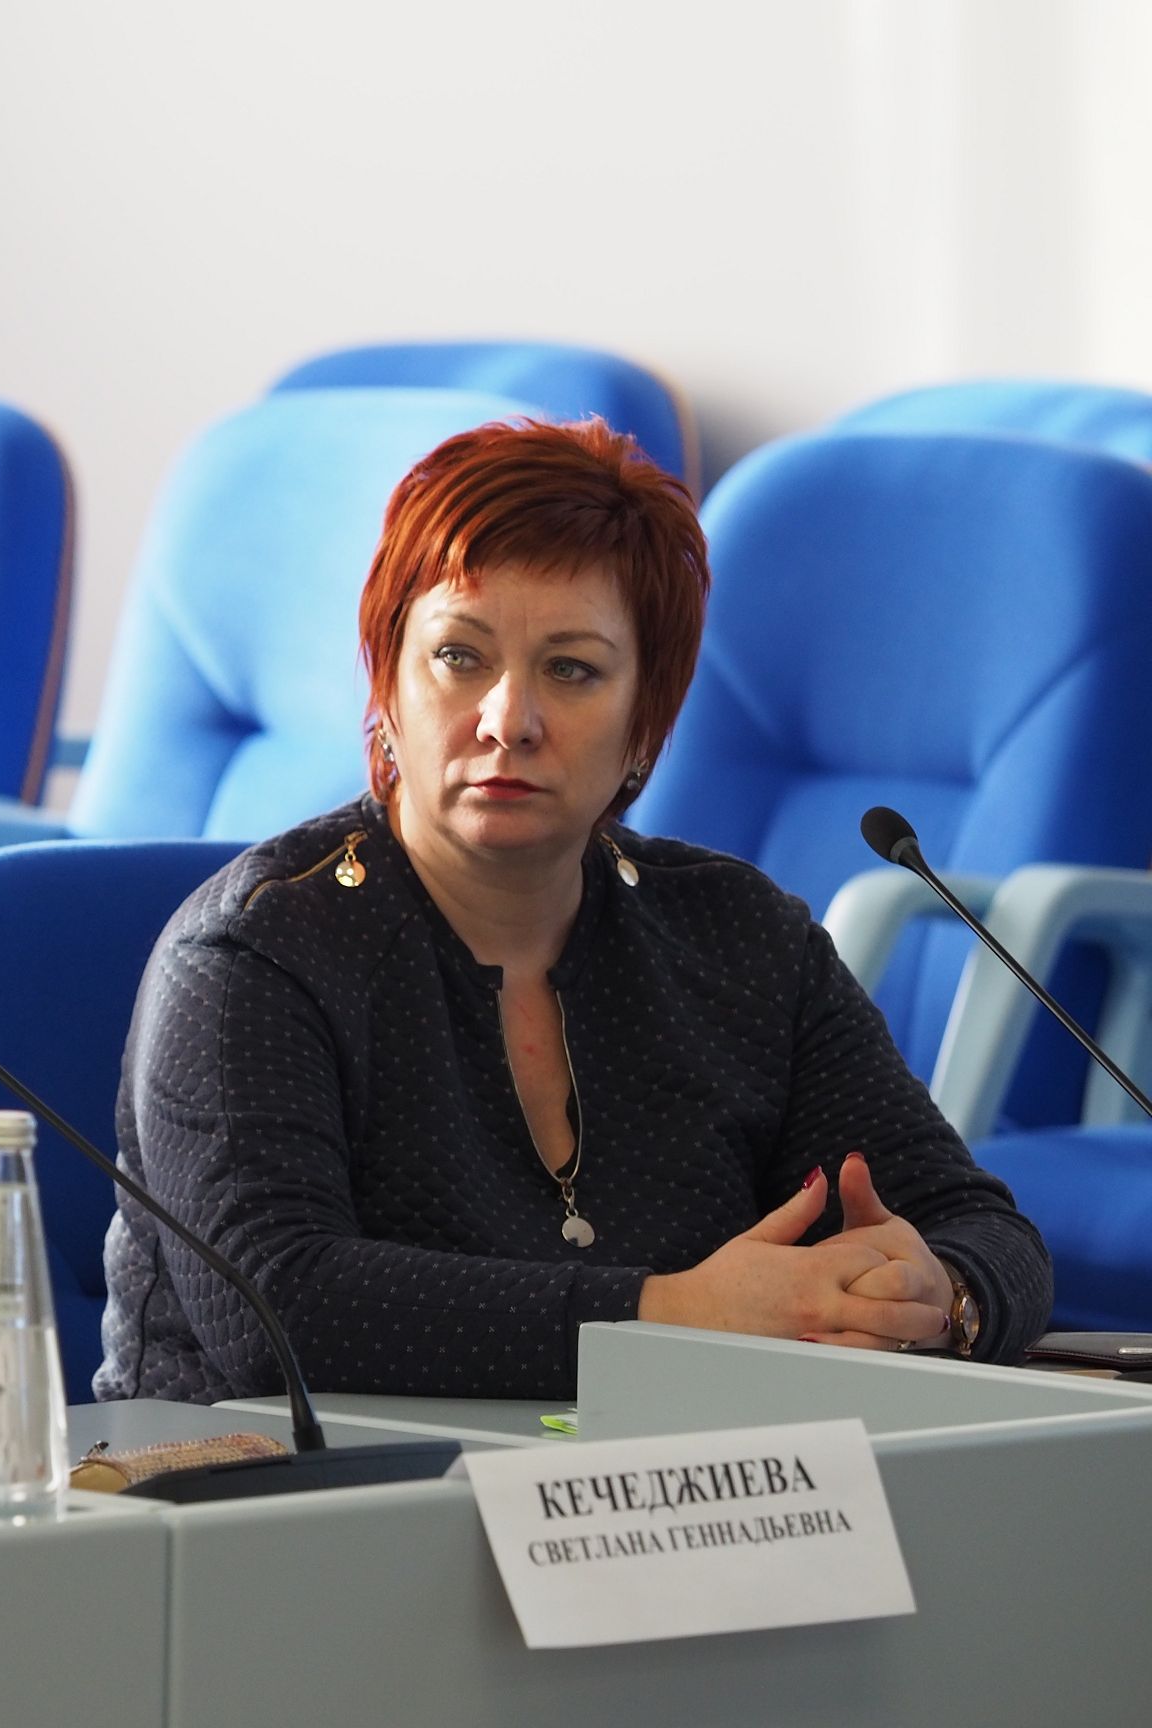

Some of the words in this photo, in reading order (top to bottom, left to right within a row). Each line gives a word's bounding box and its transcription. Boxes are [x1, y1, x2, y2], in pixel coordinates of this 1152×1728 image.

[535, 1456, 817, 1520] КЕЧЕДЖИЕВА
[528, 1529, 665, 1567] СВЕТЛАНА
[668, 1508, 853, 1552] ГЕННАДЬЕВНА
